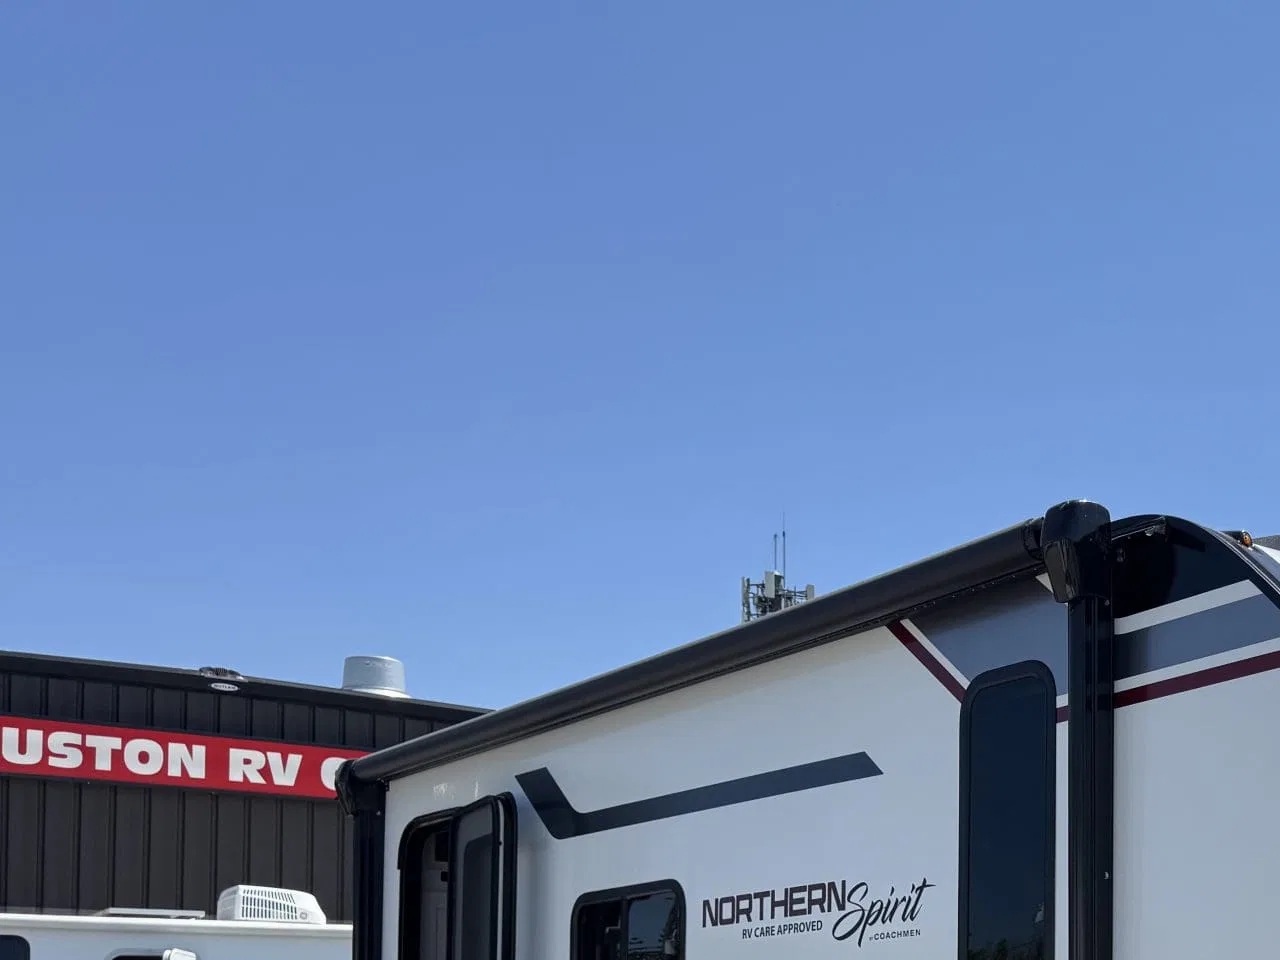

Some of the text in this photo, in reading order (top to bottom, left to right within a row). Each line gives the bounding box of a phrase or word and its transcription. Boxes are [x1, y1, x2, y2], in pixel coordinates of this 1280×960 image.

[2, 727, 206, 779] USTON
[229, 748, 303, 786] RV
[702, 877, 937, 948] NORTHERN Spirit
[742, 920, 823, 939] RV CARE APPROVED
[874, 929, 921, 941] COACHMEN
